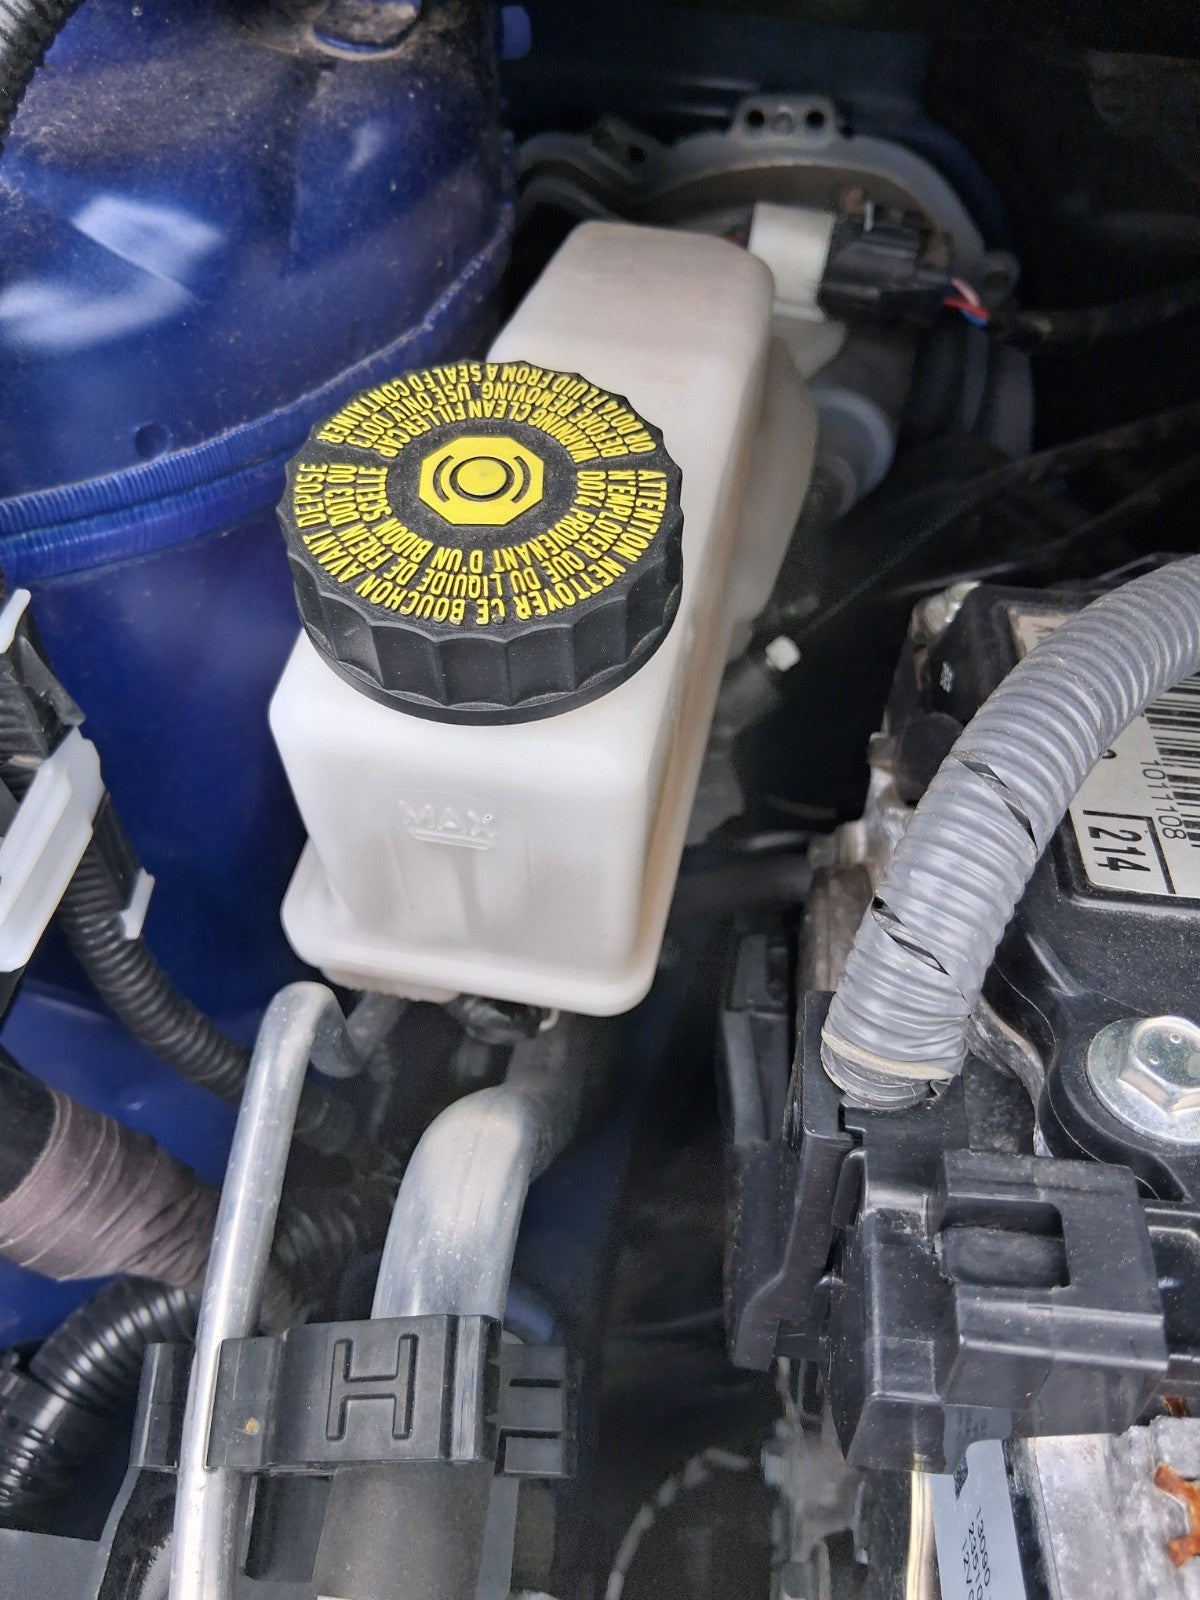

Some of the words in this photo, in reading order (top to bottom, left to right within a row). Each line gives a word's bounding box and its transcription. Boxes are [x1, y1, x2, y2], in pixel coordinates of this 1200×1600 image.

[407, 364, 482, 391] SEALED
[485, 364, 499, 381] A
[501, 365, 555, 389] FROM
[386, 392, 433, 422] ONLY
[431, 383, 471, 405] USE
[551, 376, 609, 409] FLUID
[316, 380, 410, 444] CONTAINER
[398, 402, 467, 436] FILLER
[468, 400, 532, 422] CLEAN
[598, 400, 644, 435] DOT4
[345, 413, 394, 448] DOT3
[373, 428, 411, 458] CAP
[527, 408, 600, 464] WARNING
[568, 407, 629, 458] BEFORE
[624, 431, 656, 453] OR
[326, 464, 358, 484] OU
[573, 470, 607, 508] DOT4
[294, 463, 328, 528] DEPOSE
[324, 487, 361, 527] DOT3
[355, 466, 393, 522] SCELLE
[573, 470, 637, 560] N'EMPLOYER
[611, 470, 667, 562] ATTENTION
[303, 529, 365, 582] AVANT
[337, 523, 393, 570] FREIN
[371, 517, 434, 563] BIDON
[493, 507, 596, 573] PROVENANT
[383, 557, 419, 586] DE
[430, 546, 484, 574] D'UN
[541, 550, 586, 583] QUE
[416, 568, 503, 599] LIQUIDE
[510, 566, 541, 594] DU
[513, 556, 627, 620] NETTOYER
[355, 574, 466, 625] BOUCHON
[475, 598, 506, 625] CE
[1140, 758, 1187, 840] 1011108
[398, 800, 498, 839] MAX
[1087, 826, 1151, 872] 214
[326, 1333, 419, 1441] H
